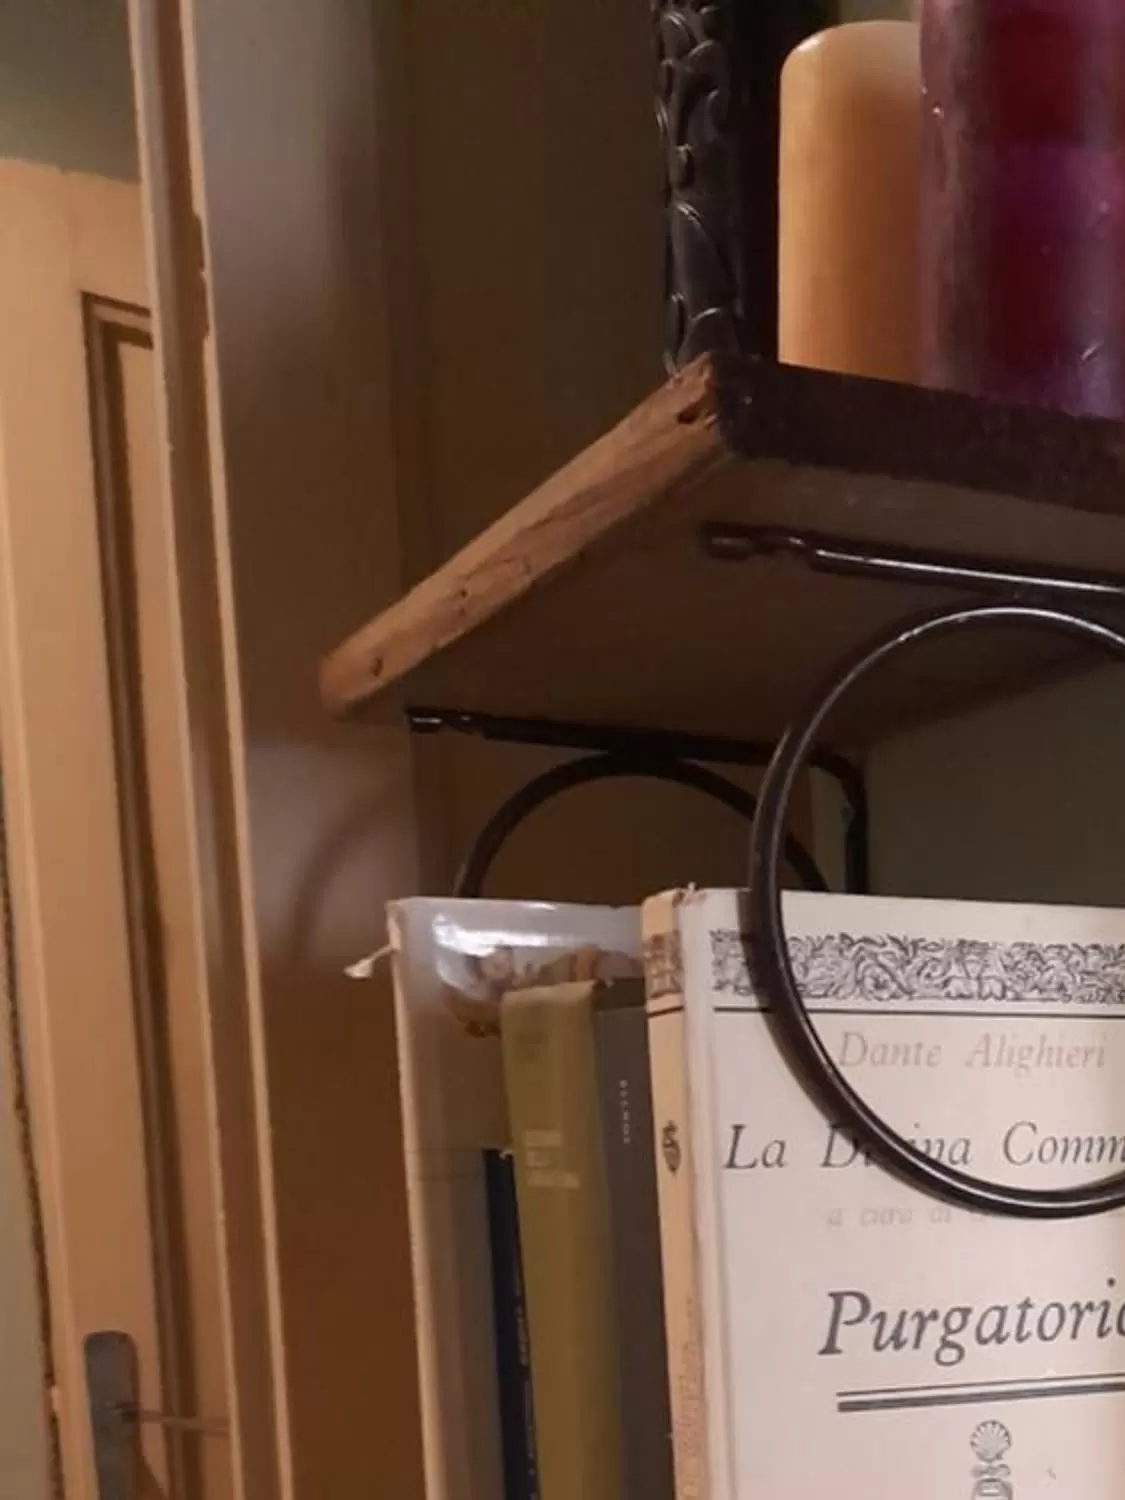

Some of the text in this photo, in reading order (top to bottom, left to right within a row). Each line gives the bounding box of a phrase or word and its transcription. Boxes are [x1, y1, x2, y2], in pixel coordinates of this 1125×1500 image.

[839, 1031, 1109, 1079] Dante Alighieri
[723, 1123, 788, 1170] La
[820, 1122, 972, 1171] Dina
